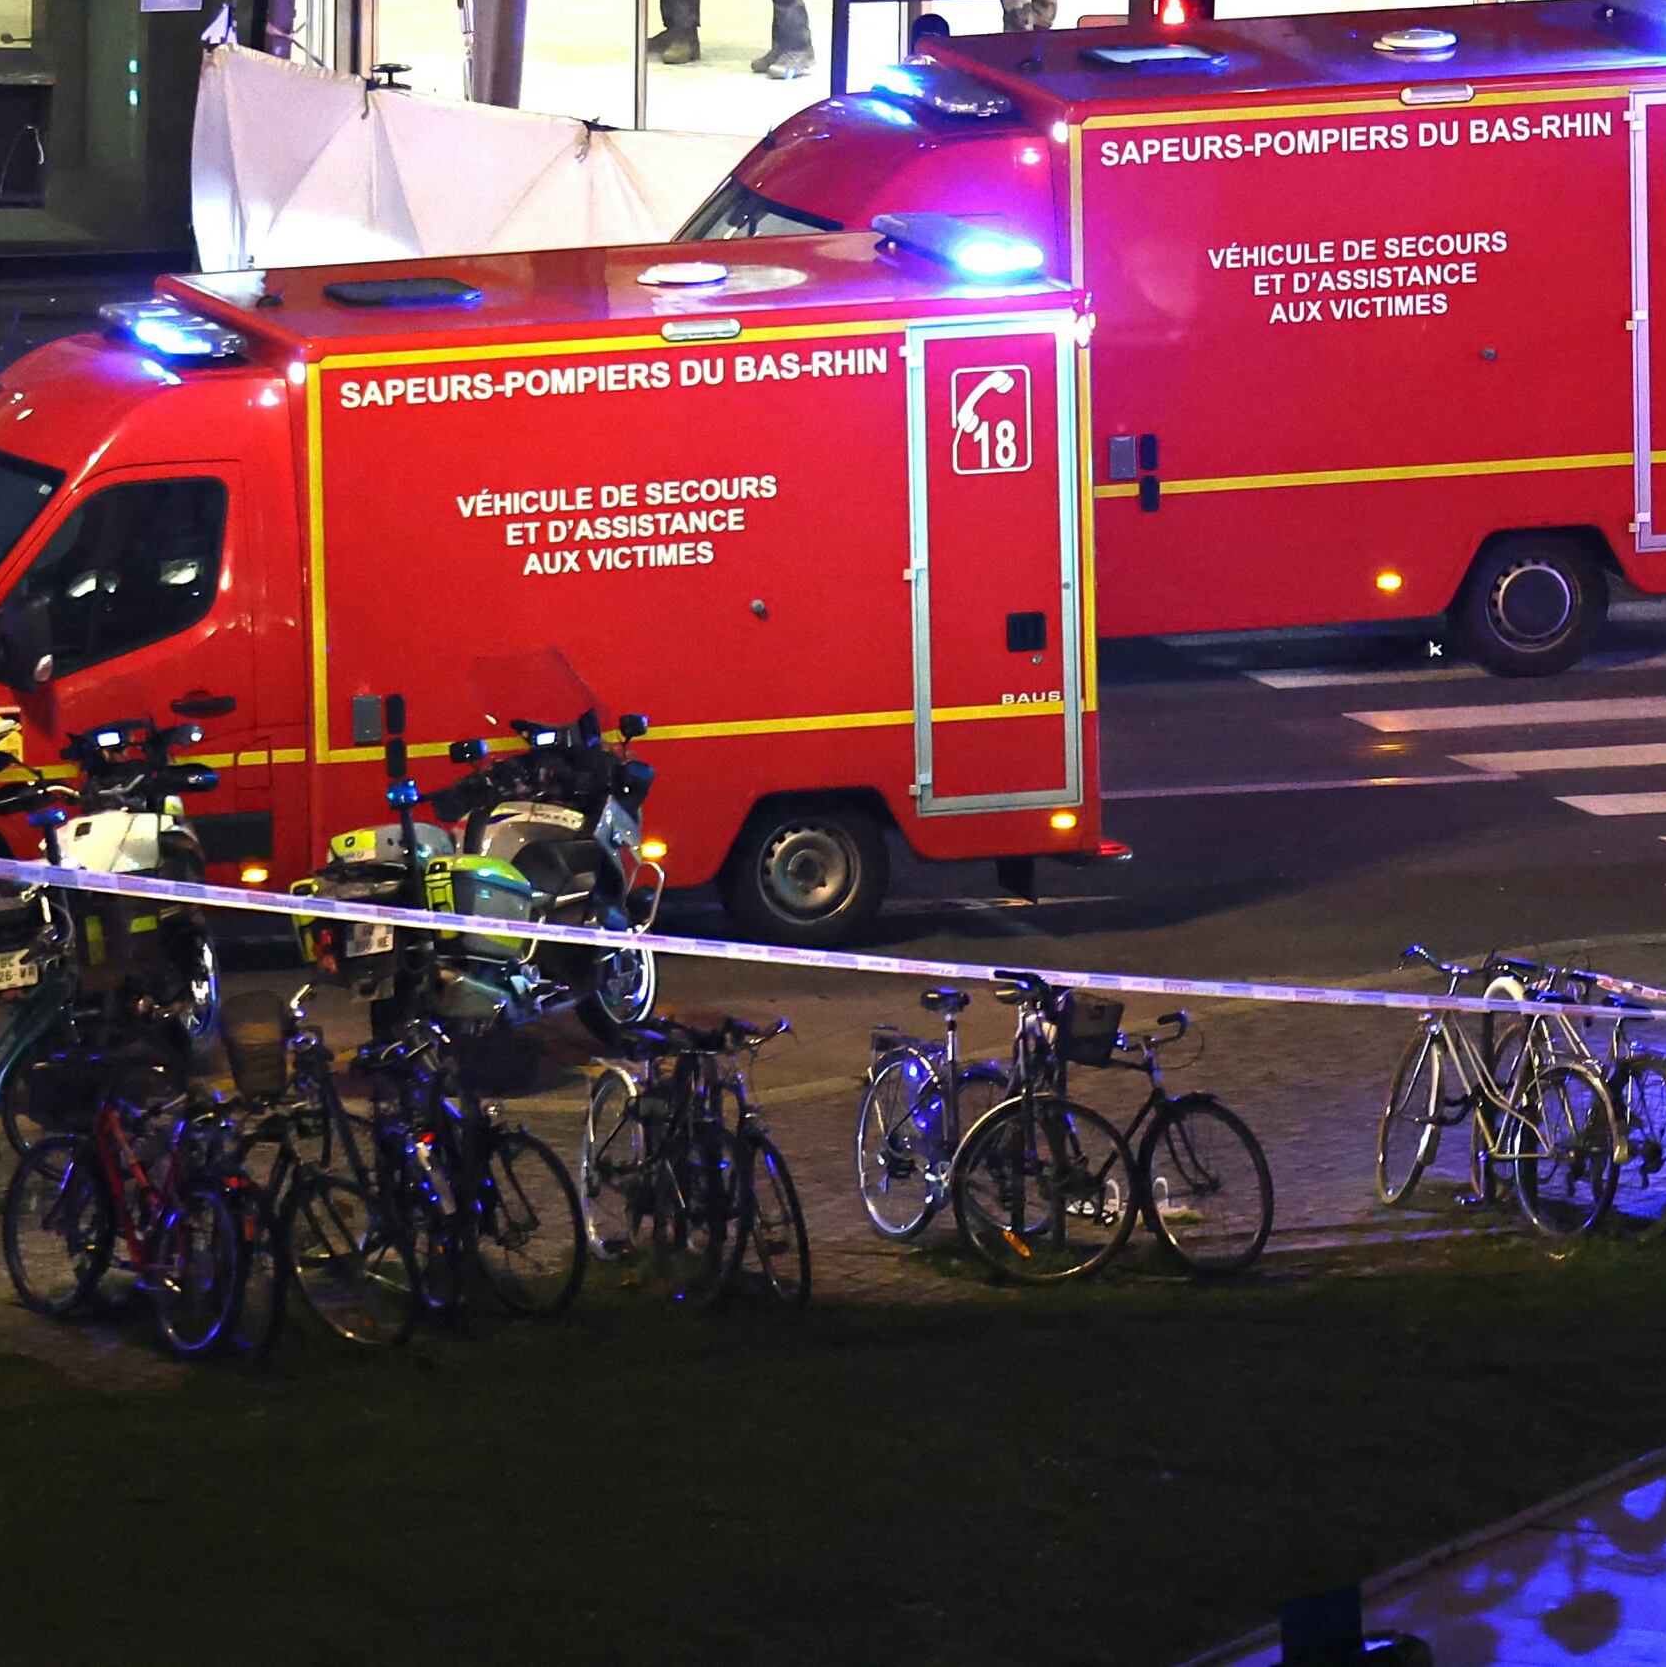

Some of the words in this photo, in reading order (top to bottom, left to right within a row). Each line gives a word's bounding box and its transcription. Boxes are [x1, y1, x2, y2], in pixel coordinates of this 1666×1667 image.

[1100, 122, 1410, 166] SAPEURS-POMPIERS
[1418, 120, 1460, 147] DU
[1469, 111, 1612, 143] BAS-RHIN
[1207, 241, 1336, 270] VÉHICULE
[1342, 239, 1377, 262] DE
[1384, 231, 1508, 259] SECOURS
[1254, 274, 1286, 296] ET
[1293, 262, 1478, 293] D'ASSISTANCE
[1269, 300, 1323, 324] AUX
[1329, 293, 1448, 320] VICTIMES
[340, 361, 672, 409] SAPEURS-POMPIERS
[679, 358, 725, 387] DU
[735, 347, 888, 383] BAS-RHIN
[973, 421, 1017, 468] 18
[456, 487, 593, 518] VÉHICULE
[600, 484, 637, 508] DE
[645, 475, 778, 505] SECOURS
[506, 522, 541, 546] ET
[548, 508, 745, 542] D'ASSISTANCE
[523, 550, 581, 576] AUX
[587, 541, 715, 571] VICTIMES
[1002, 691, 1061, 704] BAUS
